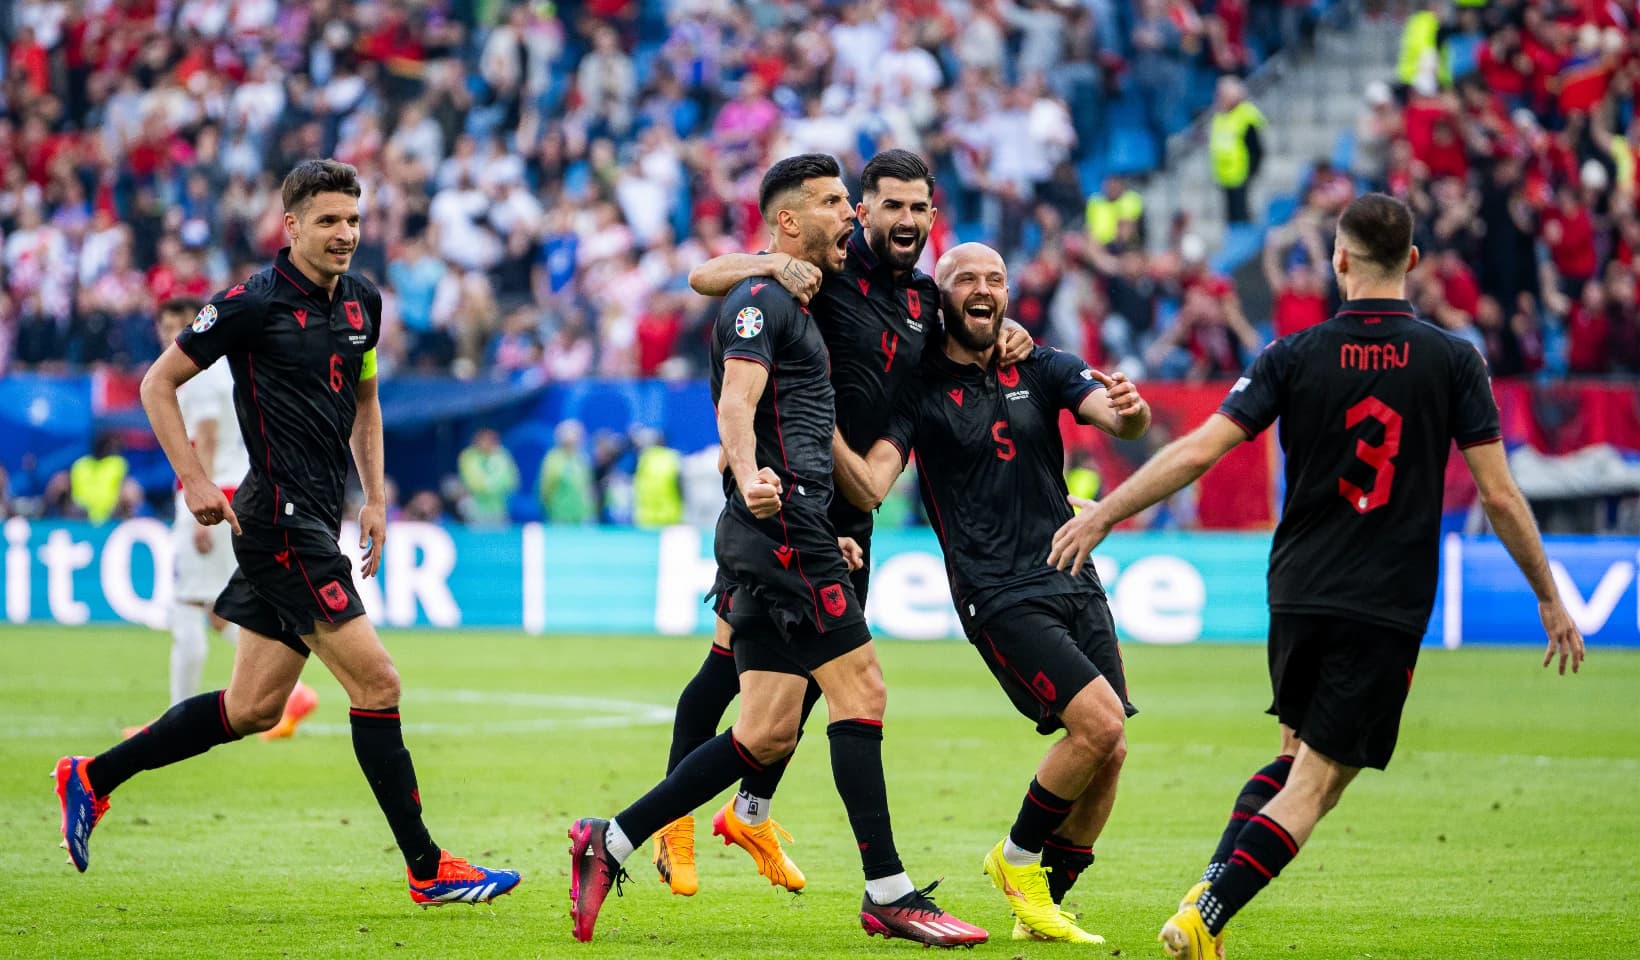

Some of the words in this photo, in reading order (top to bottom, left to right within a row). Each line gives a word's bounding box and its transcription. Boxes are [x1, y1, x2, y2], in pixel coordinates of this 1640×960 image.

[881, 329, 899, 373] 4
[1340, 341, 1409, 371] MITAJ
[329, 352, 344, 393] 6
[991, 419, 1016, 461] 5
[1338, 395, 1403, 514] 3
